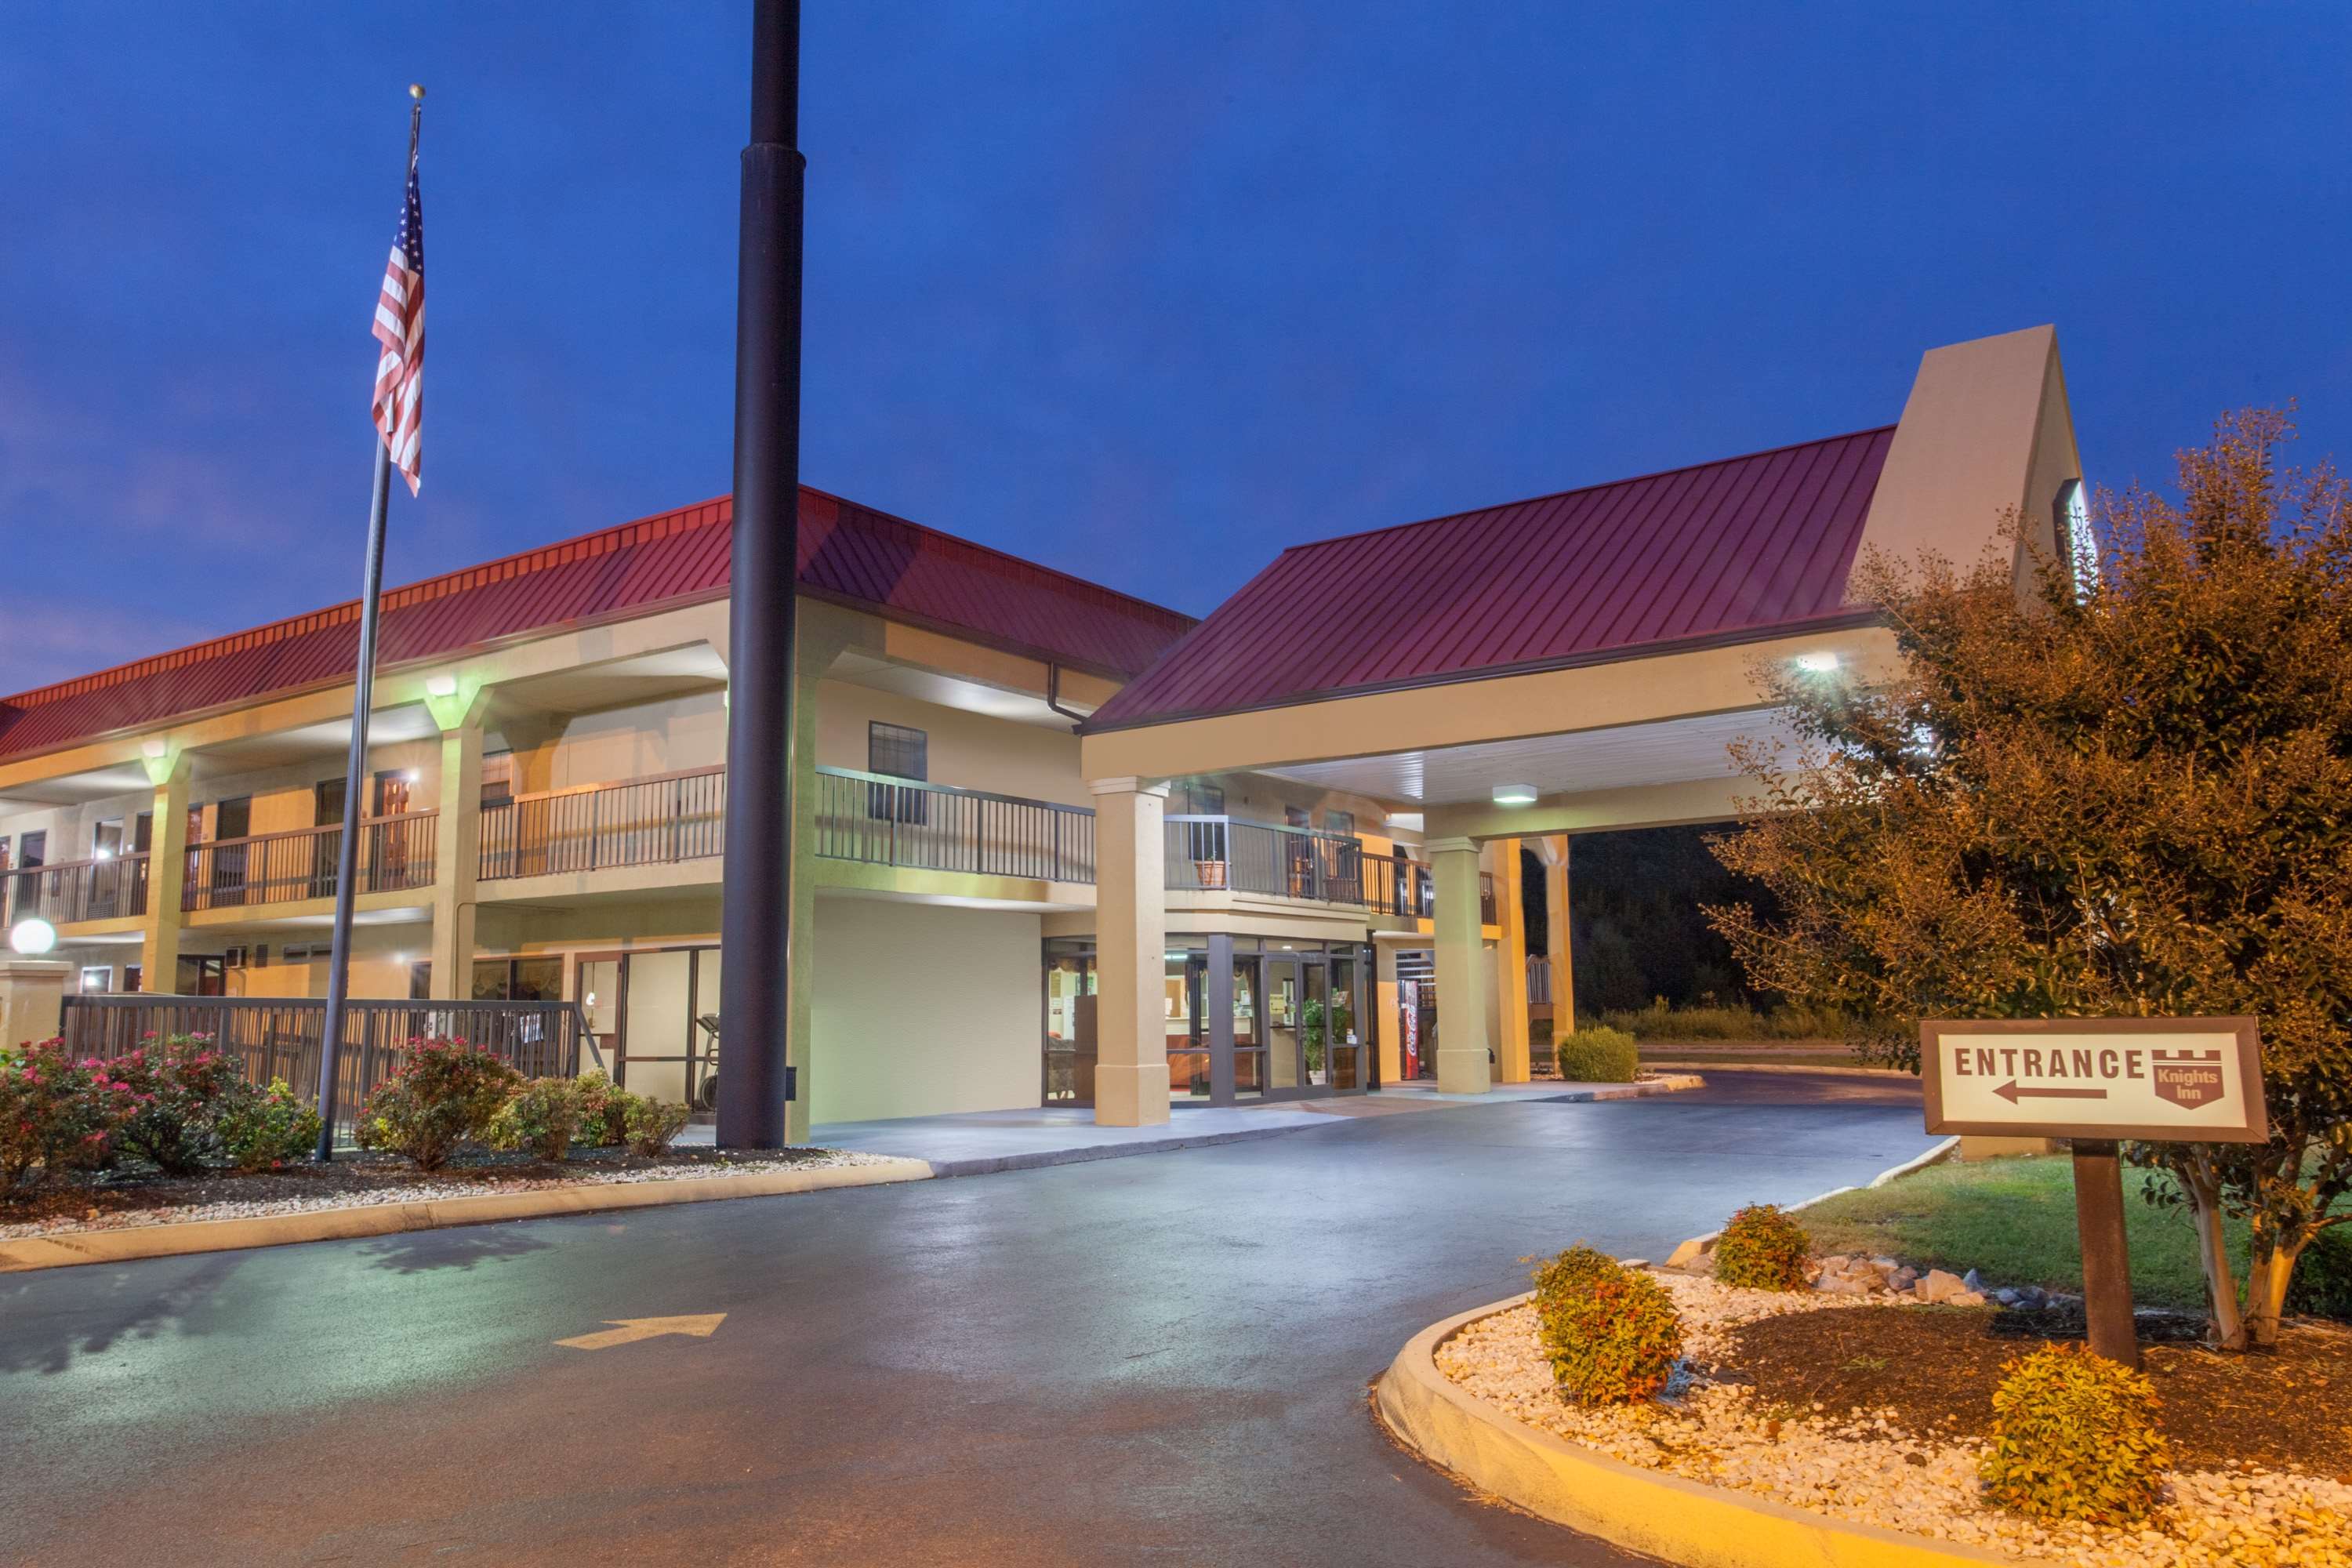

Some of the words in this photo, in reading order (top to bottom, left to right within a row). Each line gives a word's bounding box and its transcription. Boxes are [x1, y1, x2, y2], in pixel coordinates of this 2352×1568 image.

[1955, 1048, 2145, 1079] ENTRANCE
[2158, 1069, 2218, 1086] Knights
[2176, 1085, 2201, 1099] Inn
